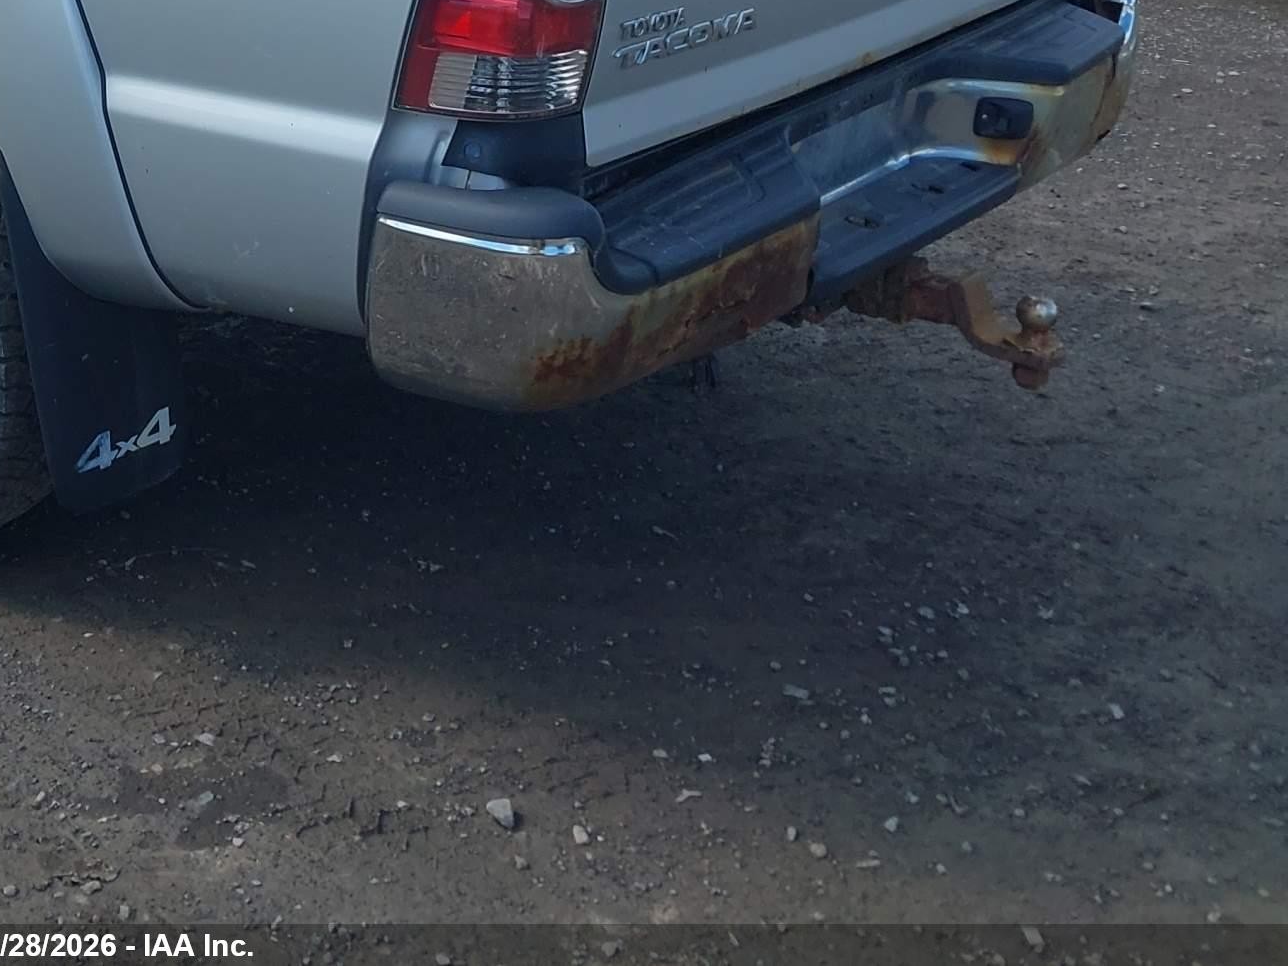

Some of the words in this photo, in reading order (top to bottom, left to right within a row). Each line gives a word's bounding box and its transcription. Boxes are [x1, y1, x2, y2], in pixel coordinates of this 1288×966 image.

[612, 8, 755, 66] TACOMA
[621, 7, 685, 39] TOYOTA
[76, 406, 177, 473] 4x4
